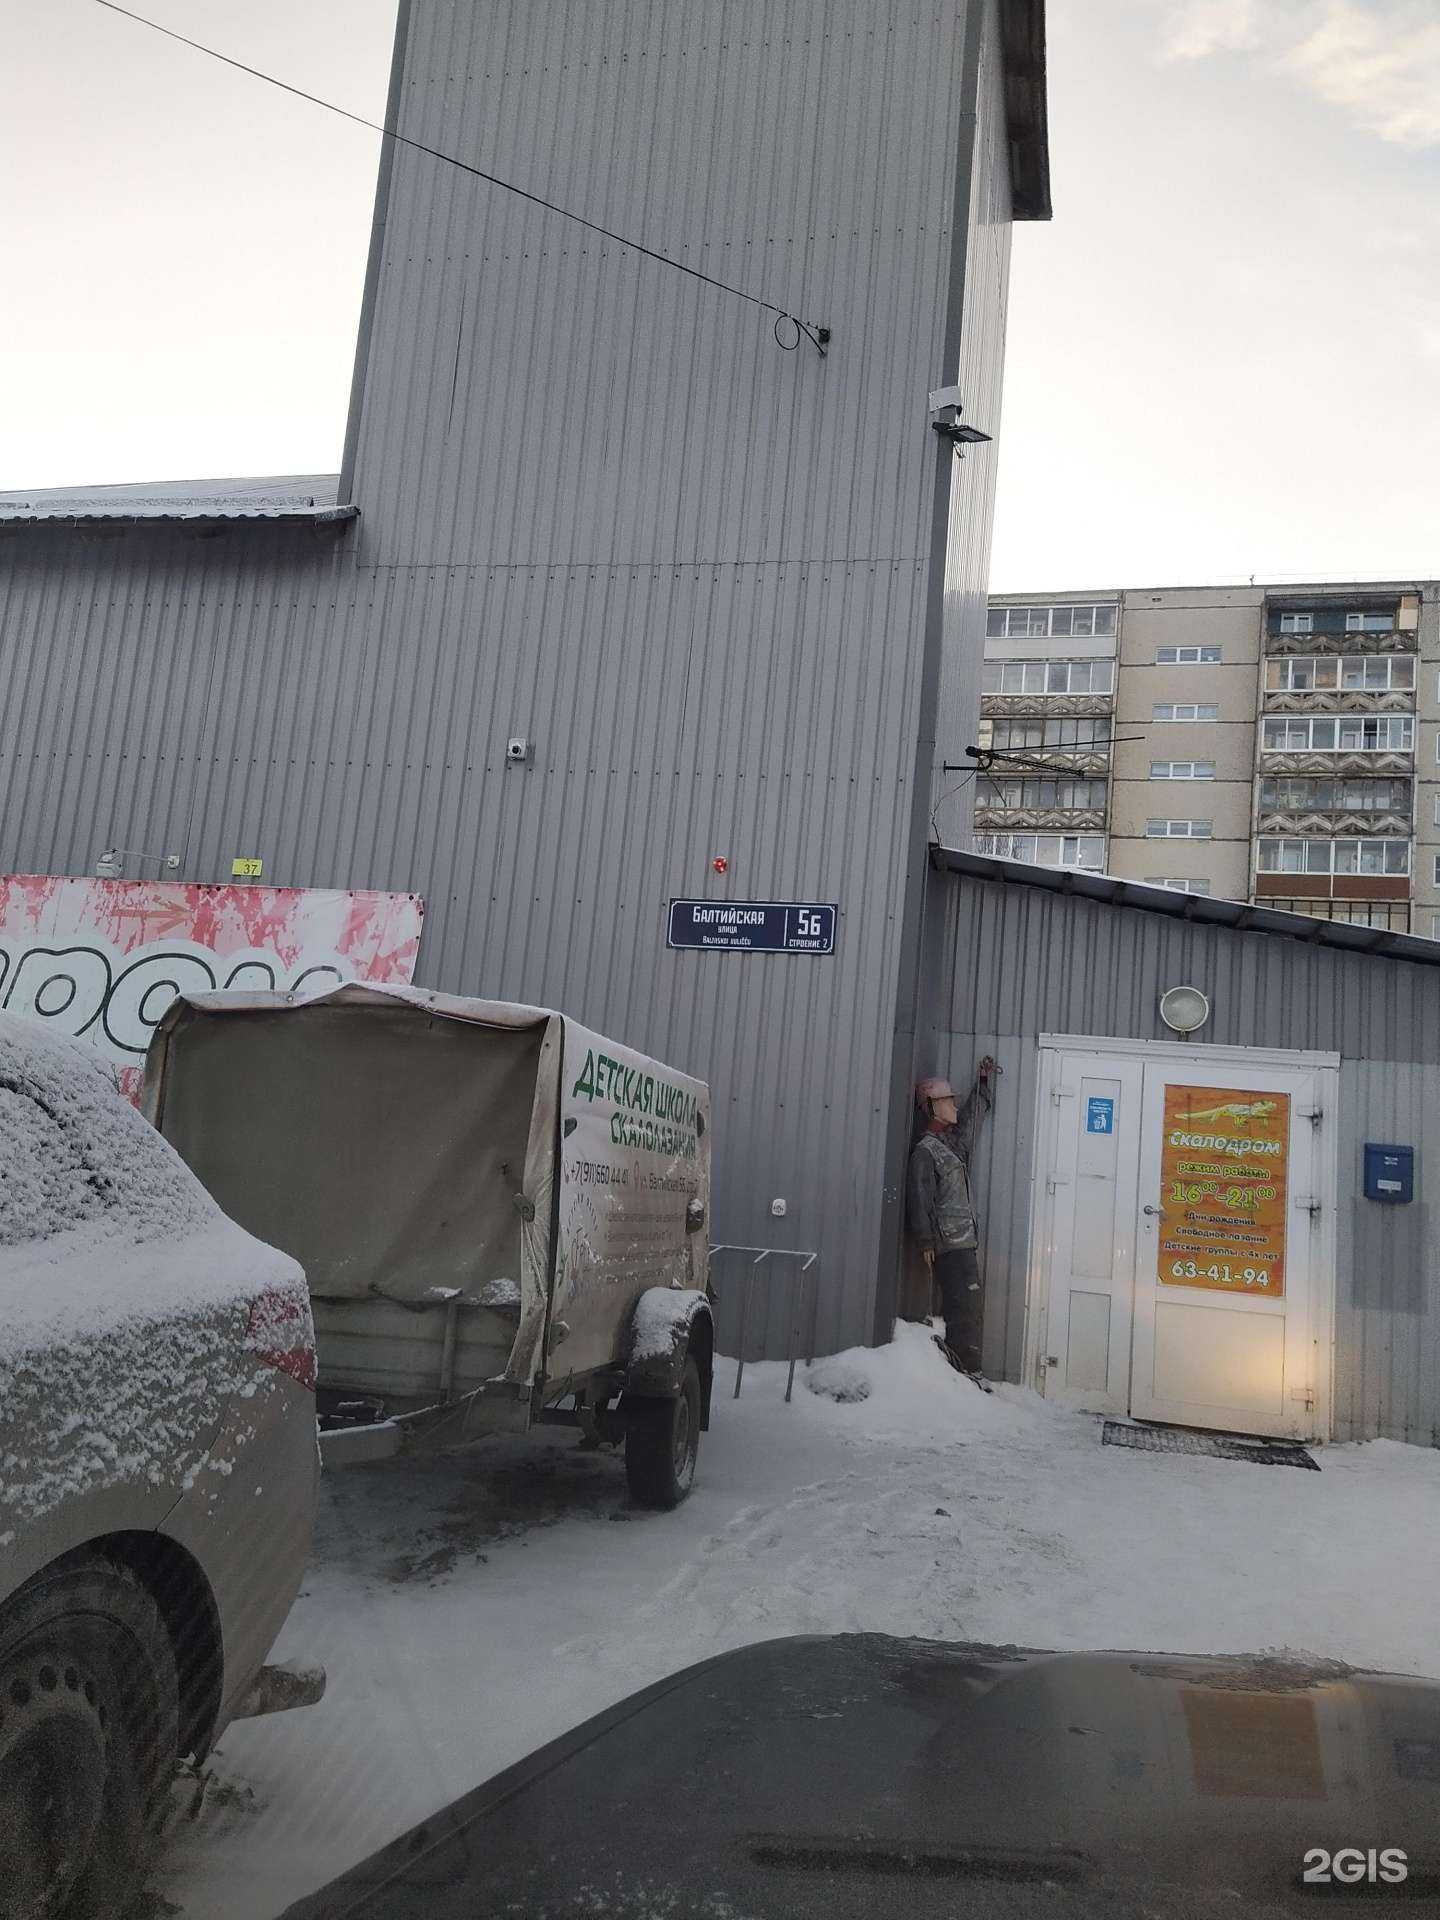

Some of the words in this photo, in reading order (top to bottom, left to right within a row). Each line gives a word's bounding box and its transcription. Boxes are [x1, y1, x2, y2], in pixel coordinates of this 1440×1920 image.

[243, 863, 258, 874] 37
[692, 906, 765, 925] БАЛТИЙСКАЯ
[717, 926, 738, 934] УЛИЦА
[789, 938, 821, 948] СТРОЕНИЕ
[822, 938, 828, 948] 2
[572, 1048, 655, 1115] ДЕТСКАЯ
[655, 1080, 697, 1129] ШКОЛА
[1178, 1162, 1221, 1175] режим
[1222, 1165, 1271, 1179] работы
[1176, 1226, 1226, 1239] Свободное
[1228, 1233, 1268, 1244] лазание
[1164, 1240, 1202, 1253] Детские
[1204, 1245, 1239, 1257] группы
[1262, 1252, 1278, 1261] лет
[1171, 1260, 1270, 1287] 63-41-94
